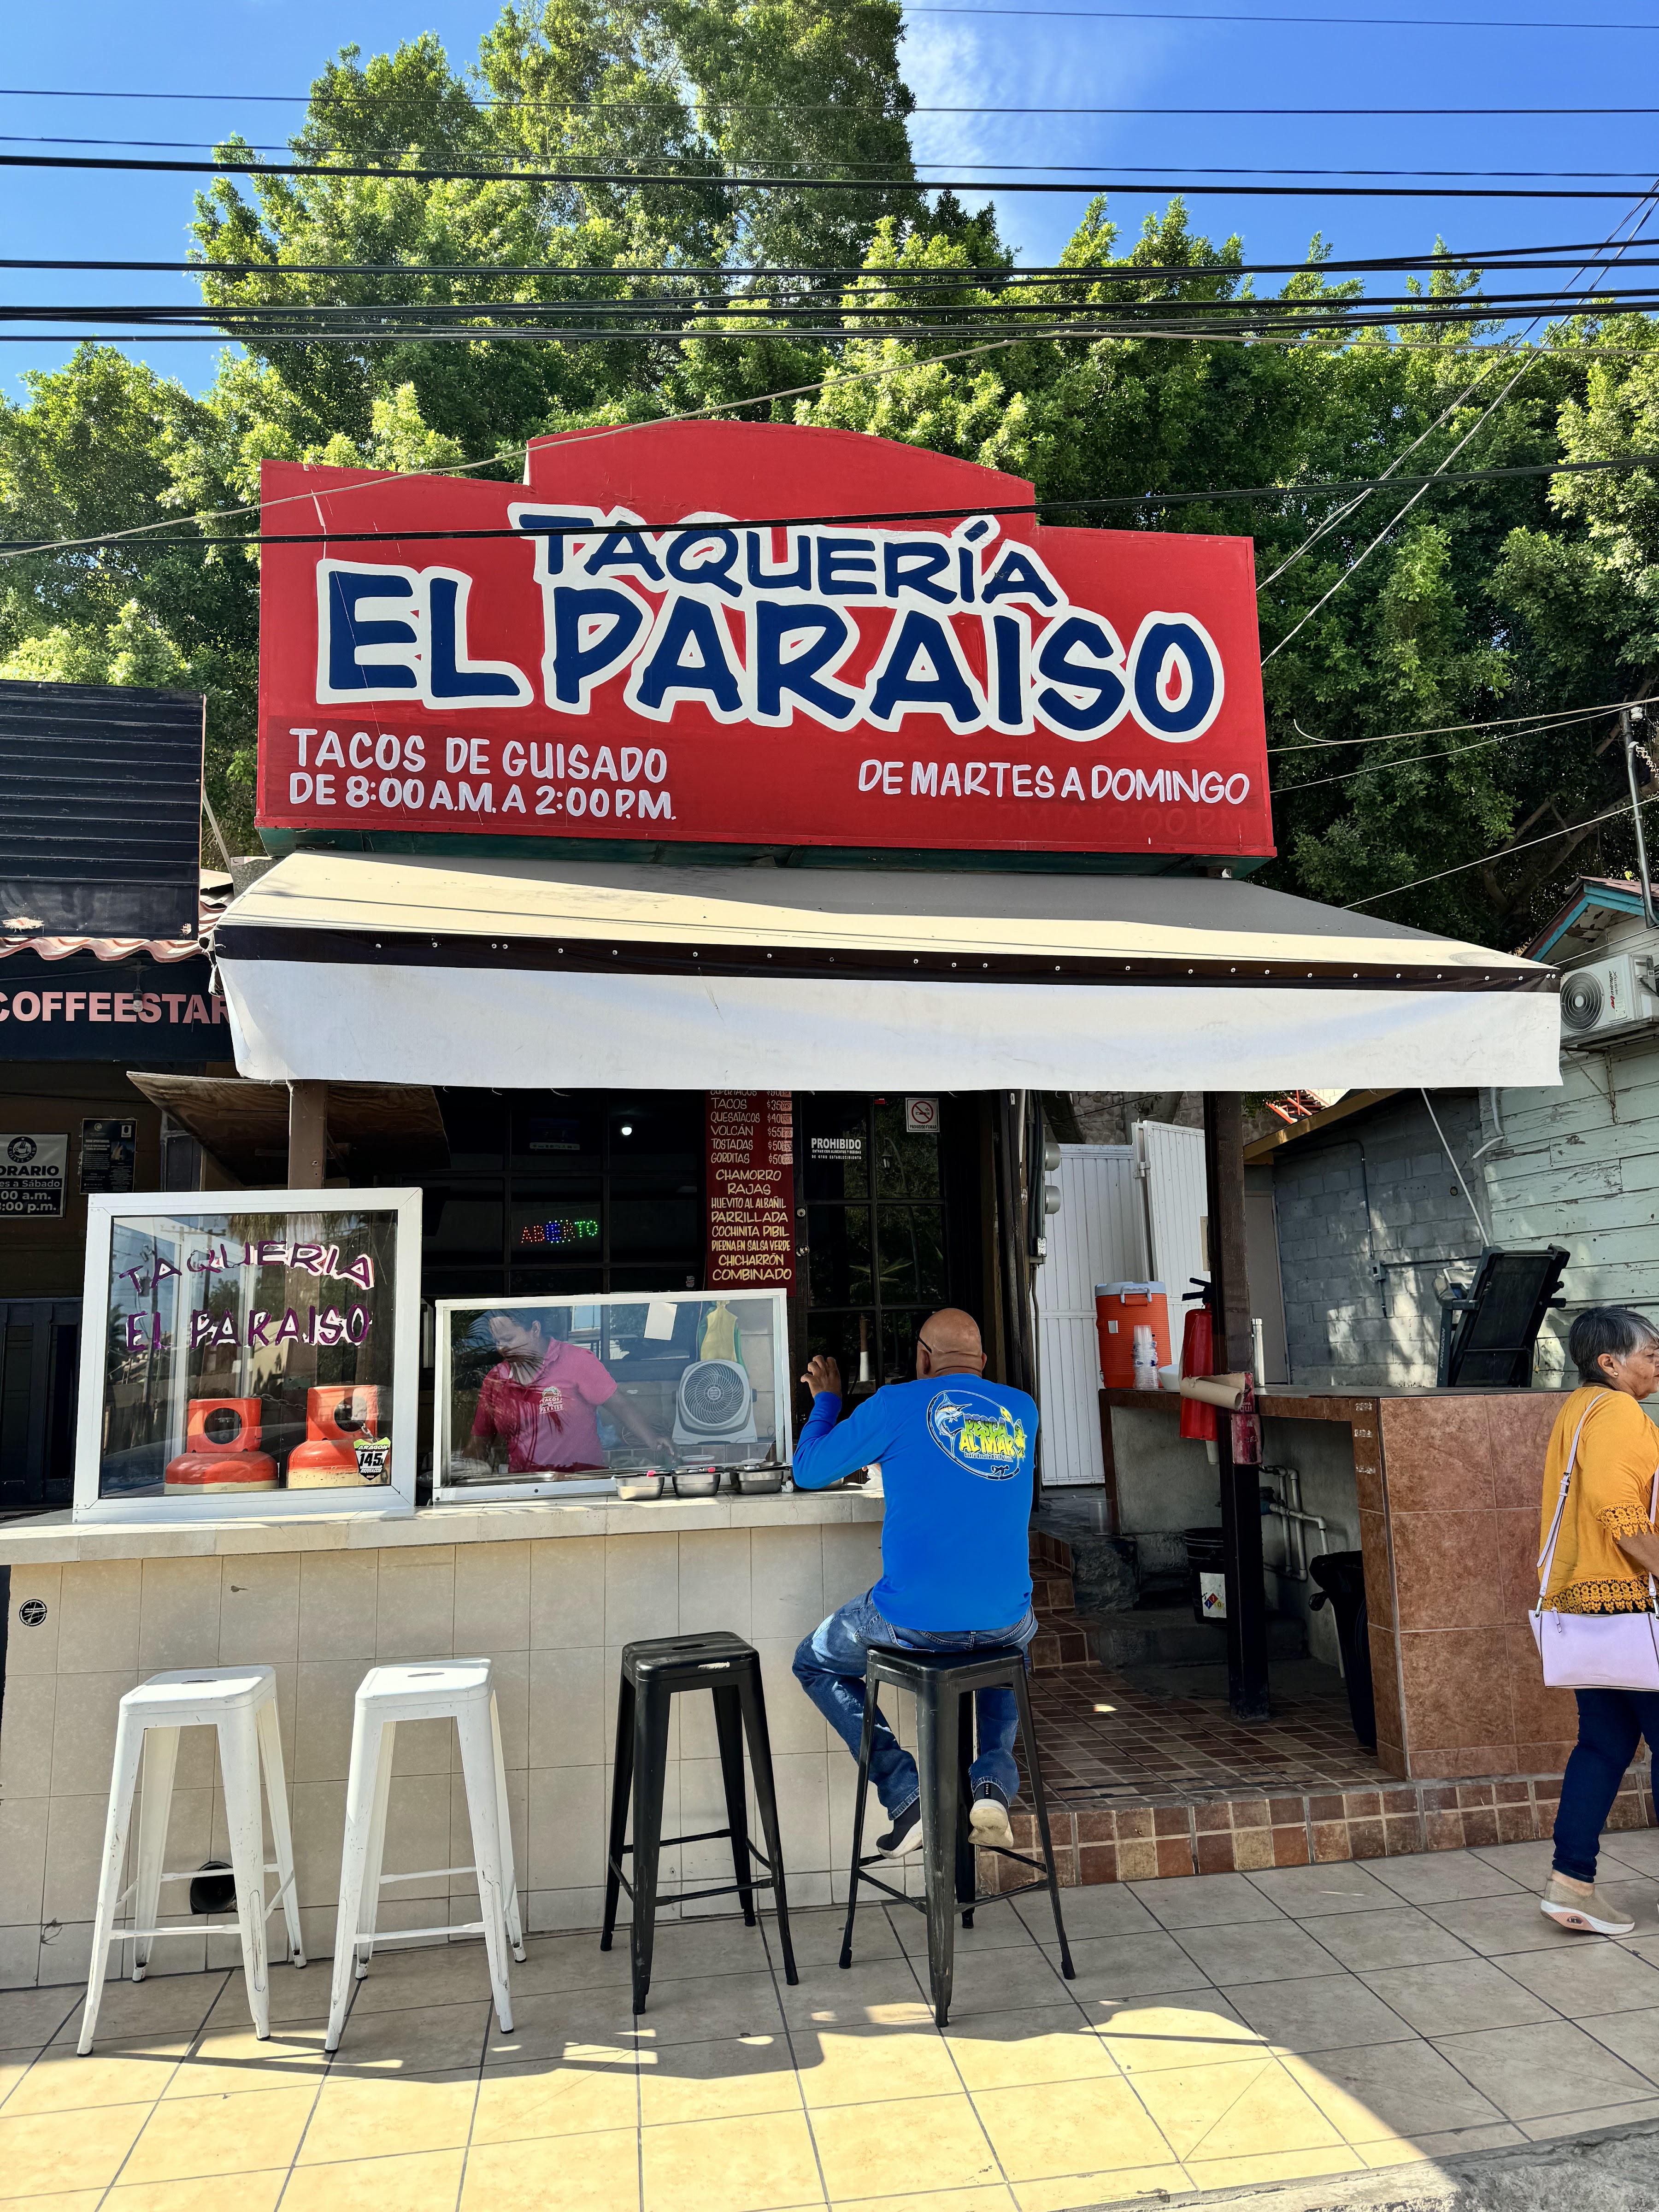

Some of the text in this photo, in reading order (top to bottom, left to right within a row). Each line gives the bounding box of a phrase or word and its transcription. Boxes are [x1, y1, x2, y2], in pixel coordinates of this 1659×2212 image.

[515, 509, 1061, 609] TAQUERÍA
[326, 567, 1218, 735] EL PARAISO
[289, 728, 667, 782] TACOS DE GUISADO
[858, 759, 1250, 804] DE MARTES A DOMINGO
[289, 772, 676, 820] DE 8:00 A.M. A 2:00 P.M.
[711, 1098, 782, 1110] TACOS $35
[711, 1112, 781, 1123] QUESATACOS $40
[711, 1124, 782, 1137] VOLCÁN $55
[711, 1138, 782, 1151] TOSTADAS $50
[812, 1138, 861, 1149] PROHIBIDO
[711, 1152, 782, 1165] GORDITAS $50
[716, 1169, 781, 1181] CHAMORRO
[728, 1182, 771, 1195] RAJAS
[27, 1203, 56, 1213] p.m.
[711, 1196, 786, 1209] HUEVITO AL ALBAÑIL
[712, 1211, 788, 1223] PARRILLADA
[521, 1221, 598, 1243] ABIERTO
[712, 1225, 789, 1237] COCHINITA PIBIL
[712, 1240, 791, 1251] PIERNA EN SALSA VERDE
[718, 1253, 784, 1266] CHICHARRÓN
[118, 1241, 374, 1292] TAQUERIA
[712, 1268, 792, 1281] COMBINADO
[126, 1304, 371, 1351] EL PARAISO
[964, 1414, 1006, 1437] PESCA
[960, 1431, 1014, 1457] AL MAR
[359, 1453, 382, 1466] 145
